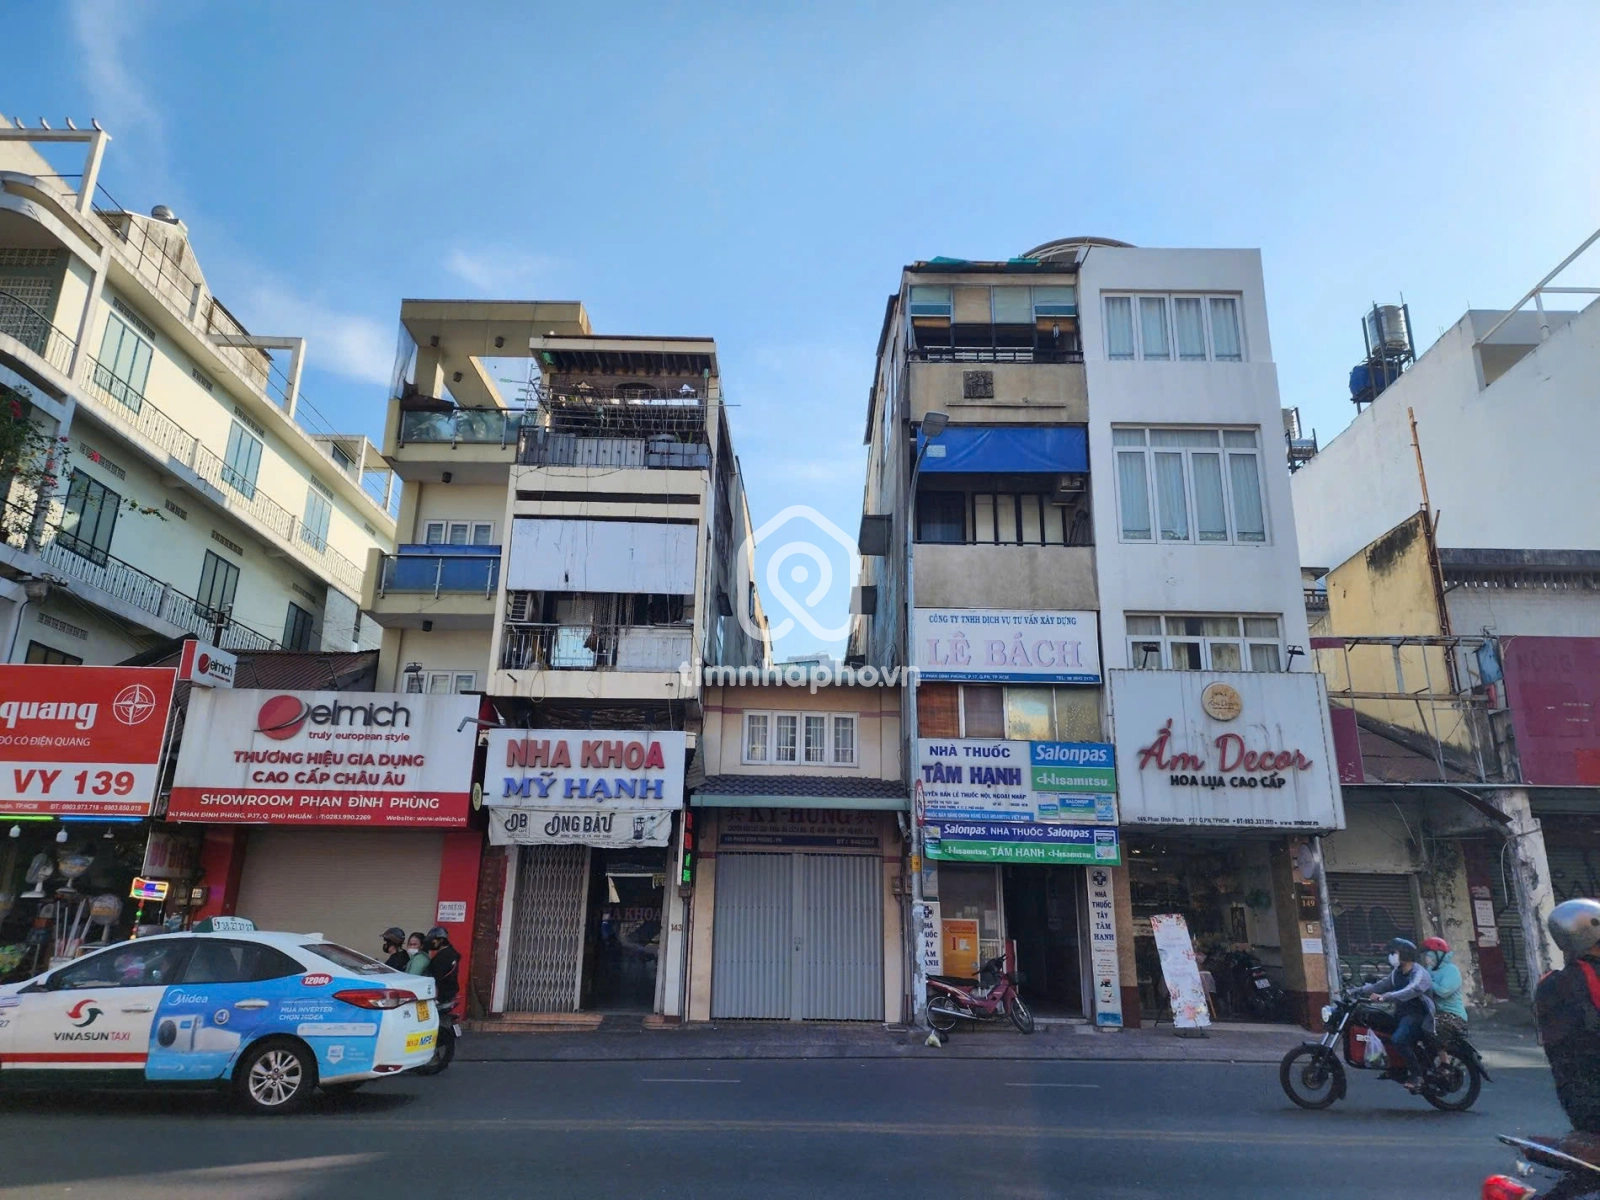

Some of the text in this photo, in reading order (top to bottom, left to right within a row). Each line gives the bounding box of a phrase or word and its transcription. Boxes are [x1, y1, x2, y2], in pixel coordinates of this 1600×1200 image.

[929, 613, 948, 624] CÔNG
[950, 615, 959, 624] TY
[961, 615, 981, 624] TNHH
[1041, 614, 1055, 625] XÂY
[926, 631, 1083, 668] LÊ BÁCH
[0, 701, 98, 730] quang
[310, 700, 411, 727] elmich
[14, 735, 29, 746] CÓ
[30, 735, 53, 747] ĐIỆN
[54, 737, 91, 747] QUANG
[309, 731, 410, 742] truly european style
[507, 739, 665, 770] NHA KHOA
[929, 743, 1011, 758] NHÀ THUỐC
[1035, 744, 1107, 765] Salonpas
[1215, 733, 1313, 773] Decor
[234, 750, 424, 769] THƯƠNG HIỆU GIA DỤNG
[14, 769, 135, 796] VY 139
[252, 767, 406, 786] CAO CẤP CHÂU ÂU
[922, 762, 1021, 788] TÂM HẠNH
[1170, 771, 1286, 790] HOA LỤA CAO CẤP
[502, 771, 557, 798] MỸ
[563, 778, 664, 803] HẠNH
[201, 793, 439, 809] SHOWROOM PHAN ĐÌNH PHÙNG
[544, 811, 580, 837] ÔNG
[944, 824, 1090, 839] Salonpas NHÀ THUỐC Salonpas
[990, 845, 1013, 858] TÂM
[1095, 890, 1107, 898] NHÀ
[1092, 899, 1112, 909] THUỐC
[1097, 911, 1108, 919] TÂY
[1096, 922, 1111, 930] TÂM
[925, 949, 936, 957] ÂM
[304, 976, 331, 986] 12004
[169, 990, 209, 1005] Midea
[54, 1032, 131, 1041] VINASUN TAXI
